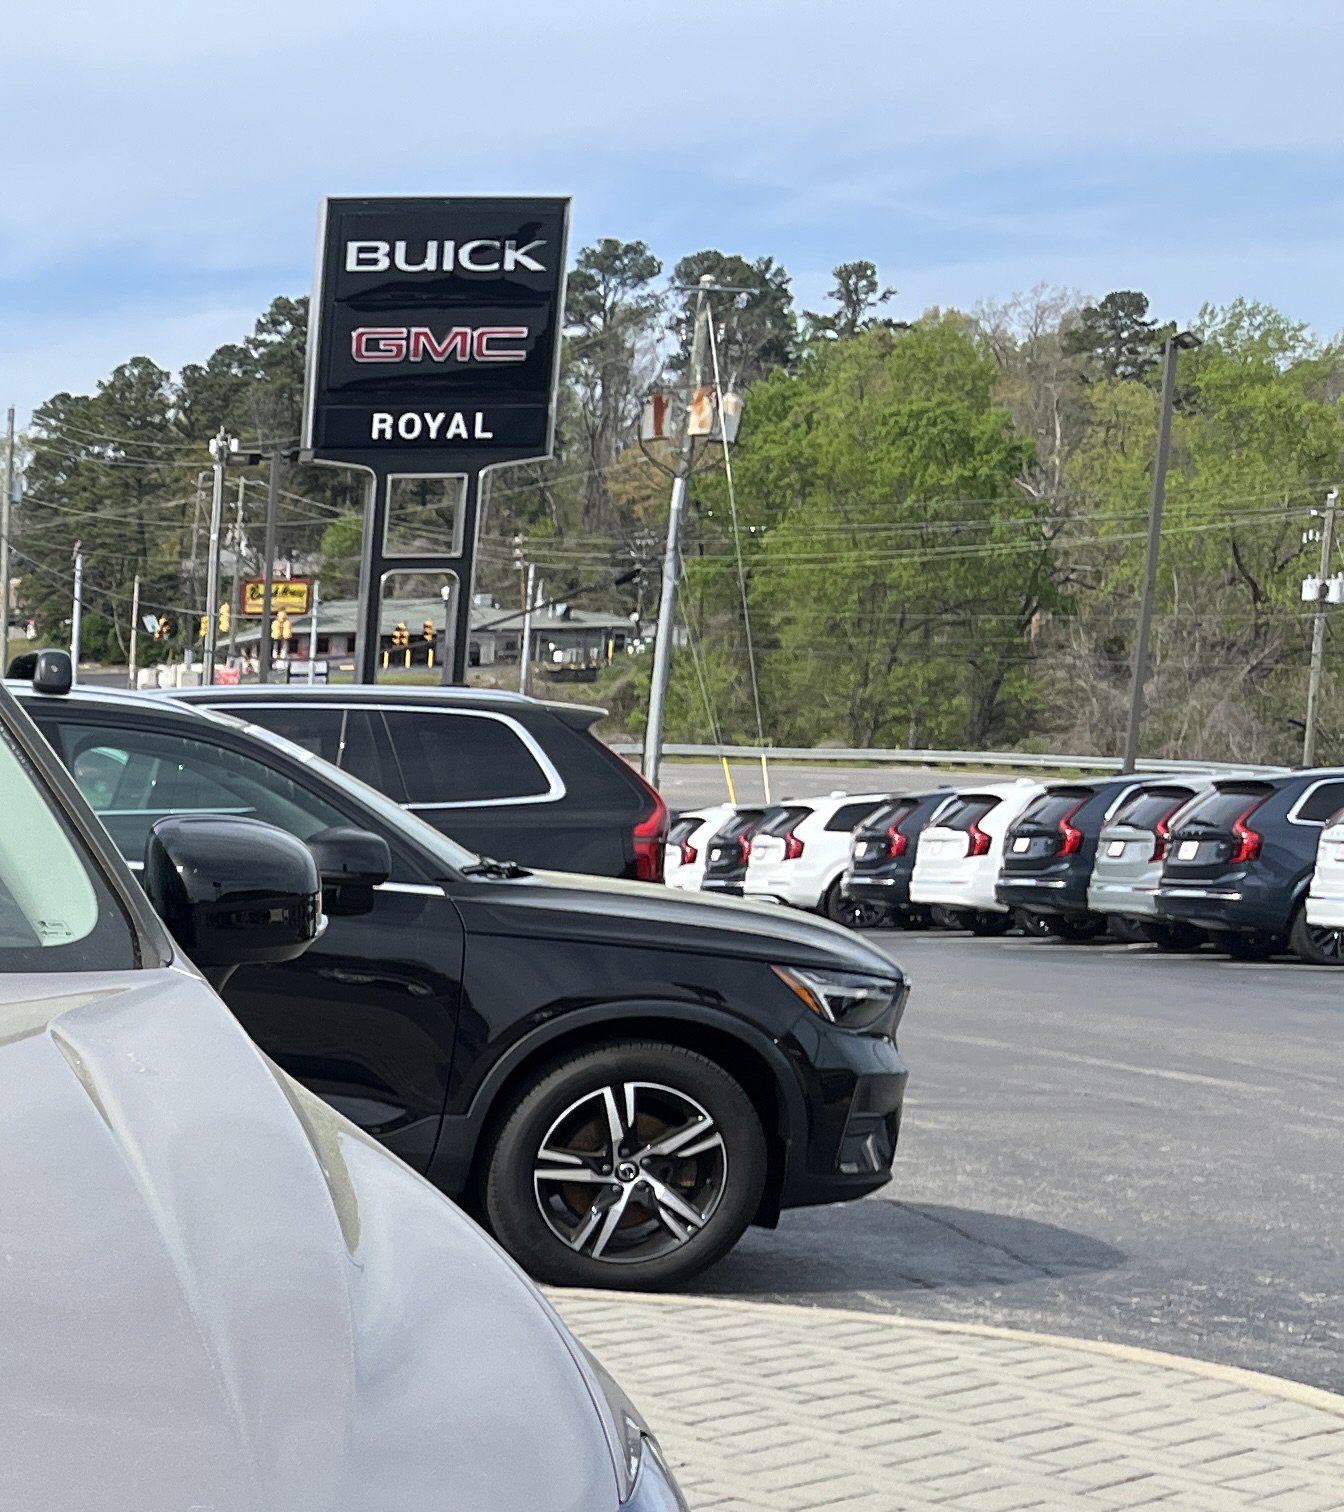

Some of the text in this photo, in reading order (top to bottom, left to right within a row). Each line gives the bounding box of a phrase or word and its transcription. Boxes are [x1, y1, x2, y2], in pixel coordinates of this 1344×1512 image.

[345, 239, 548, 272] BUICK
[351, 326, 529, 362] GMC
[371, 411, 494, 440] ROYAL
